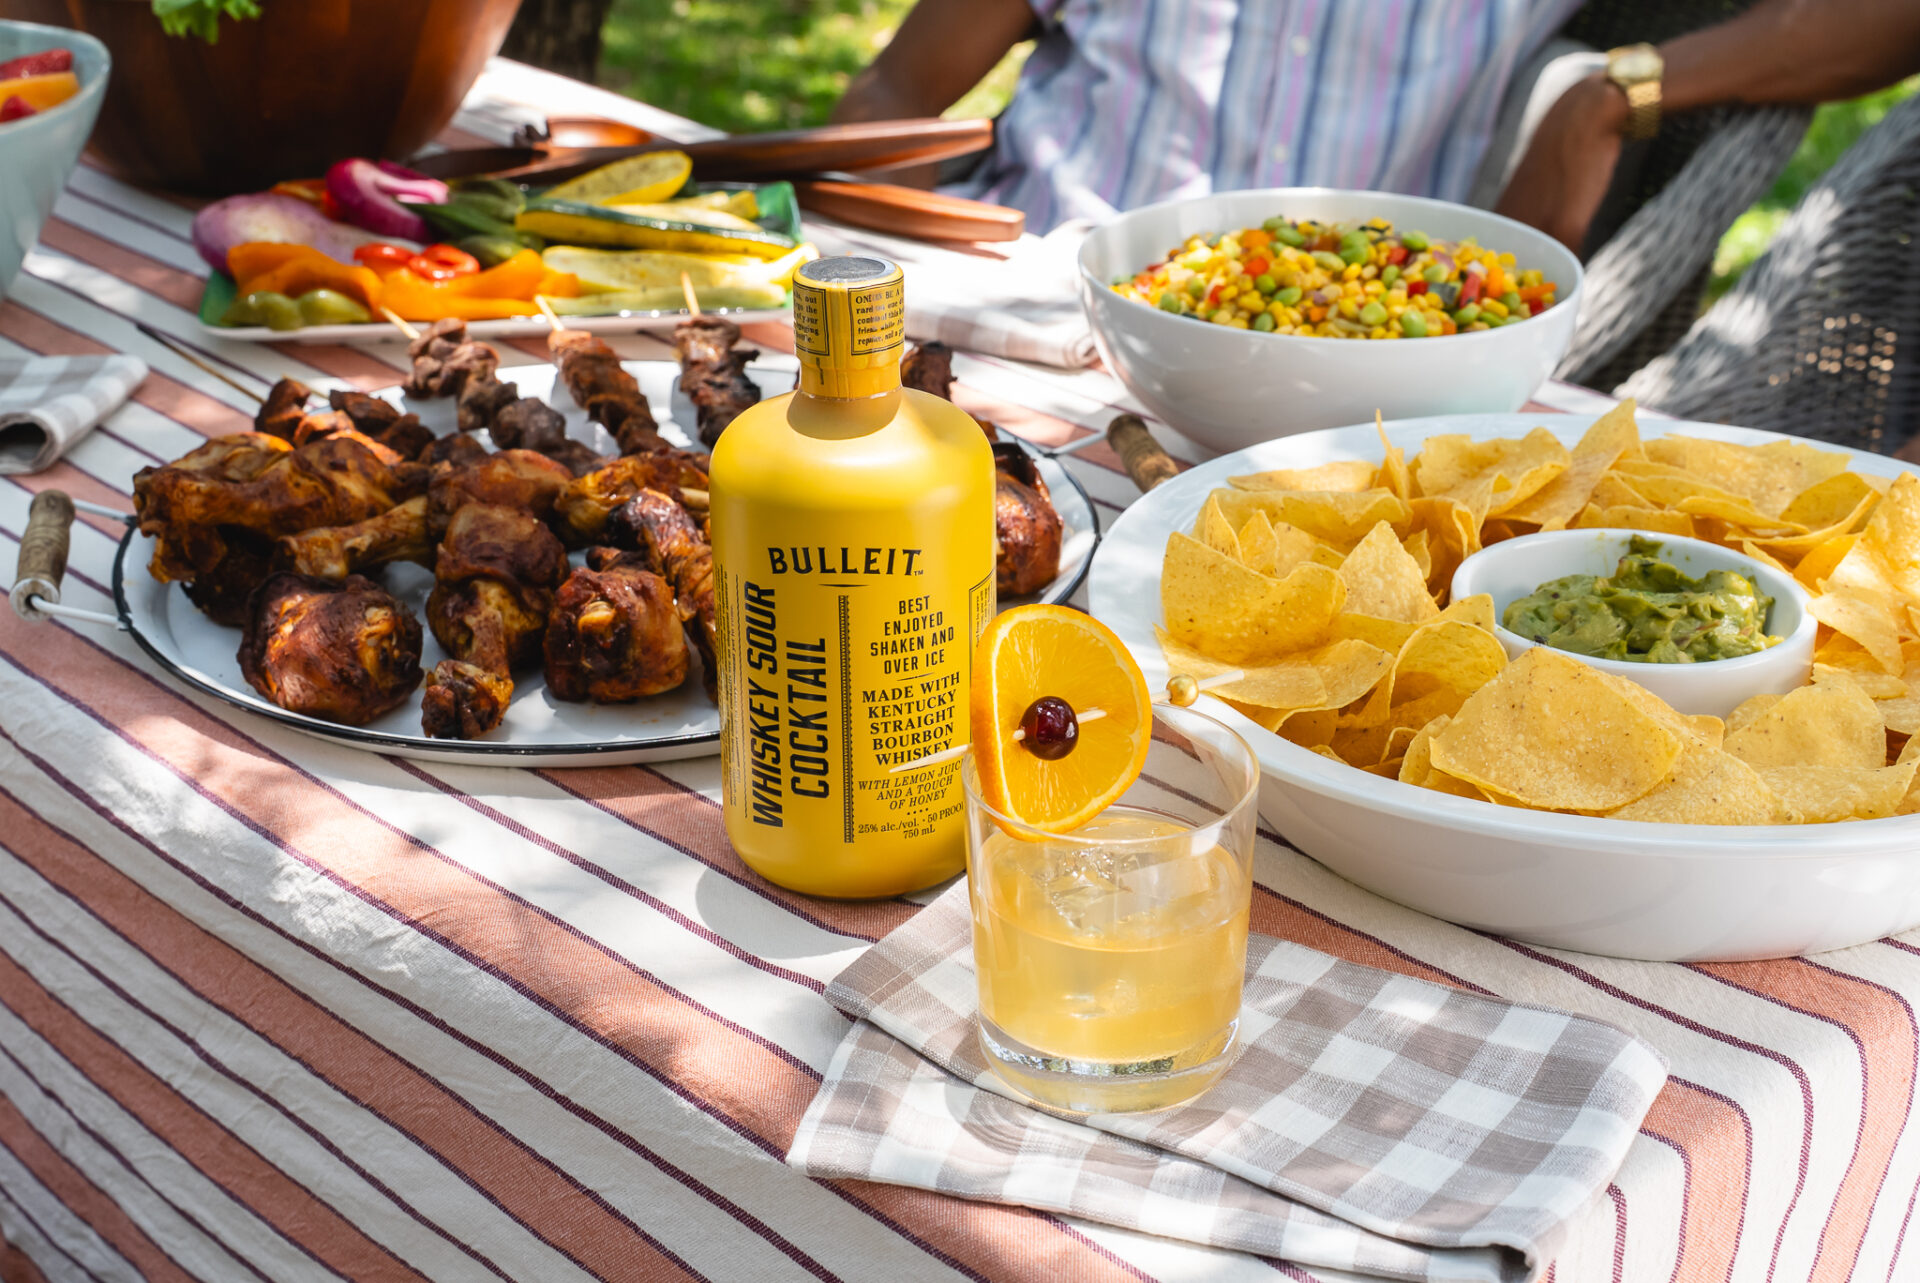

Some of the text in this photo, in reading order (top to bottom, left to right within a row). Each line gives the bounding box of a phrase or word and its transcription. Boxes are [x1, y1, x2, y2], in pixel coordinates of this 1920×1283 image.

[768, 547, 922, 575] BULLEIT
[899, 595, 930, 615] BEST
[884, 611, 943, 636] ENJOYED
[870, 626, 954, 657] SHAKEN AND
[884, 648, 945, 674] OVER ICE
[862, 671, 961, 703] MADE WITH
[744, 581, 784, 828] WHISKEY SOUR
[868, 688, 957, 719] KENTUCKY
[786, 637, 830, 799] COCKTAIL
[870, 706, 955, 735] STRAIGHT
[872, 722, 954, 750] BOURBON
[875, 739, 952, 766] WHISKEY
[858, 757, 963, 791] WITH LEMON JUIC
[876, 775, 953, 801] AND A TOUCH
[889, 788, 947, 810] OF HONEY
[858, 824, 879, 833] 25%
[880, 819, 919, 832] alc./vol.
[927, 813, 938, 823] 50
[903, 824, 936, 839] 750 mL
